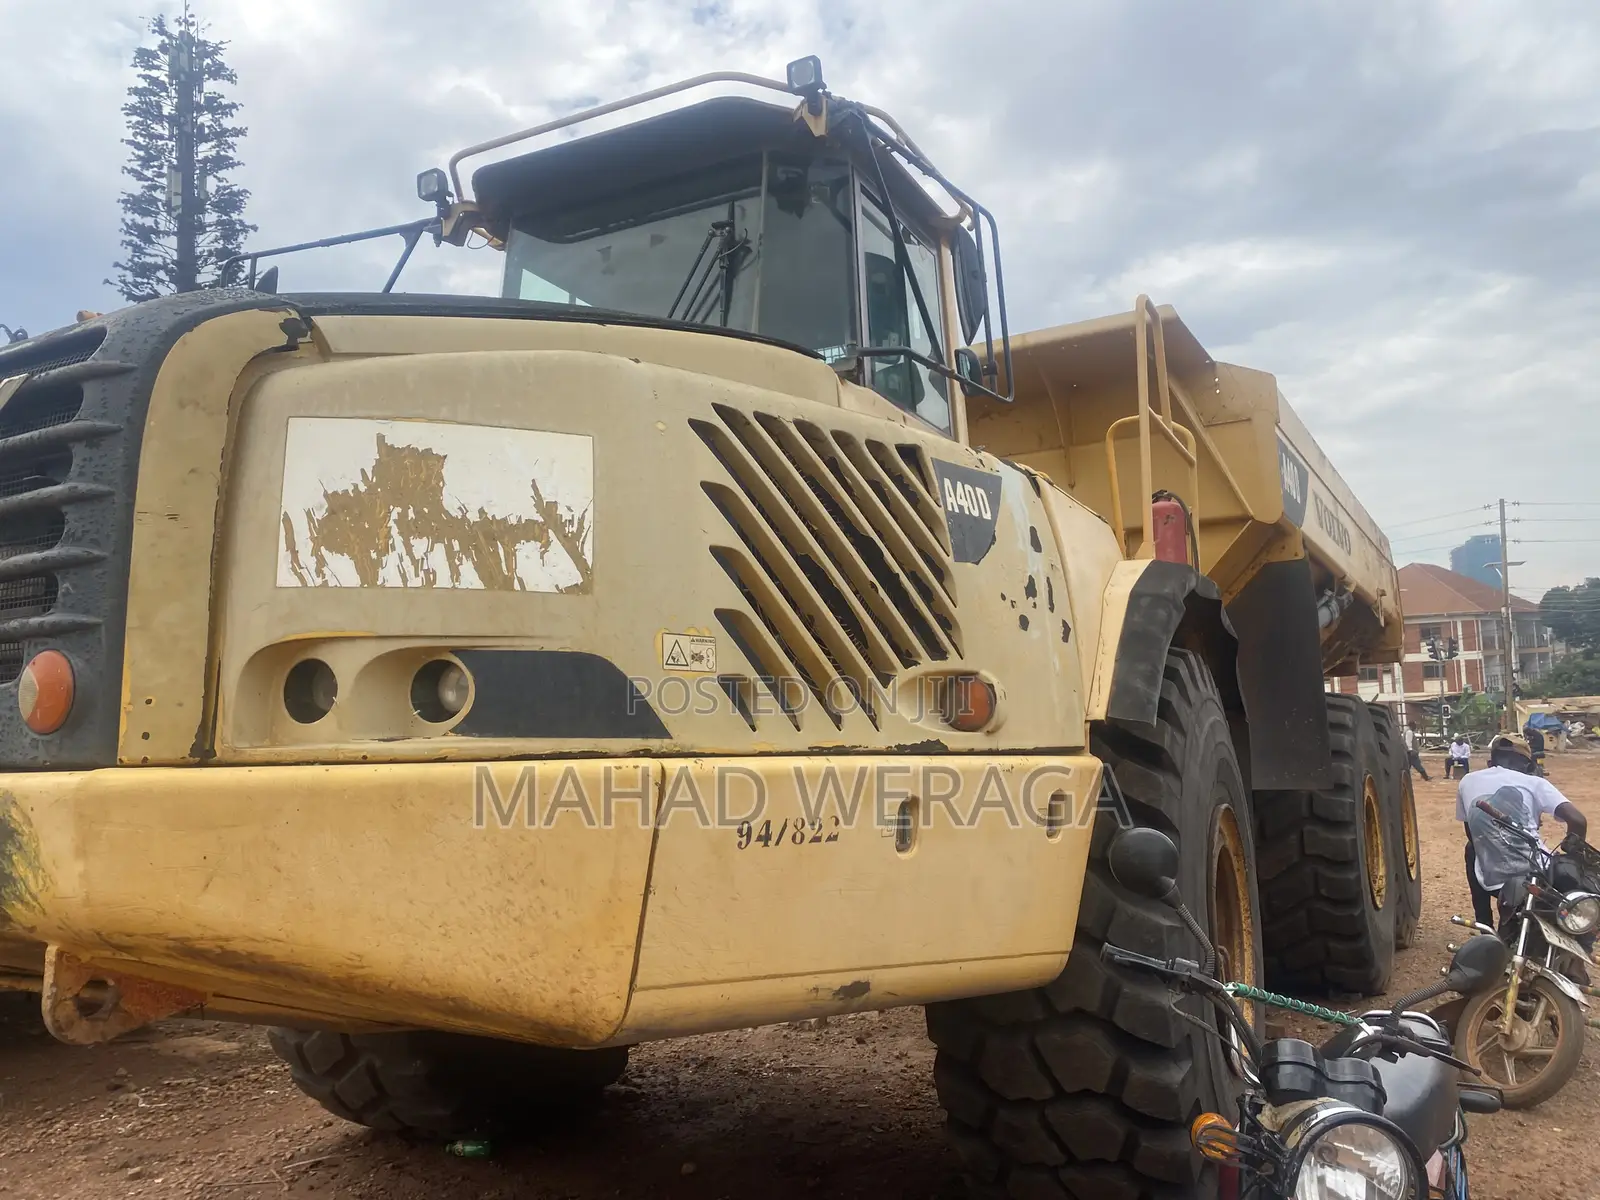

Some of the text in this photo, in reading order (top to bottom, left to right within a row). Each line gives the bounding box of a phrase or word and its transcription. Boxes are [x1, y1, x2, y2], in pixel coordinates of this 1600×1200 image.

[943, 477, 992, 520] A40D
[1312, 488, 1352, 557] VOLVO
[736, 815, 840, 851] 94/822
